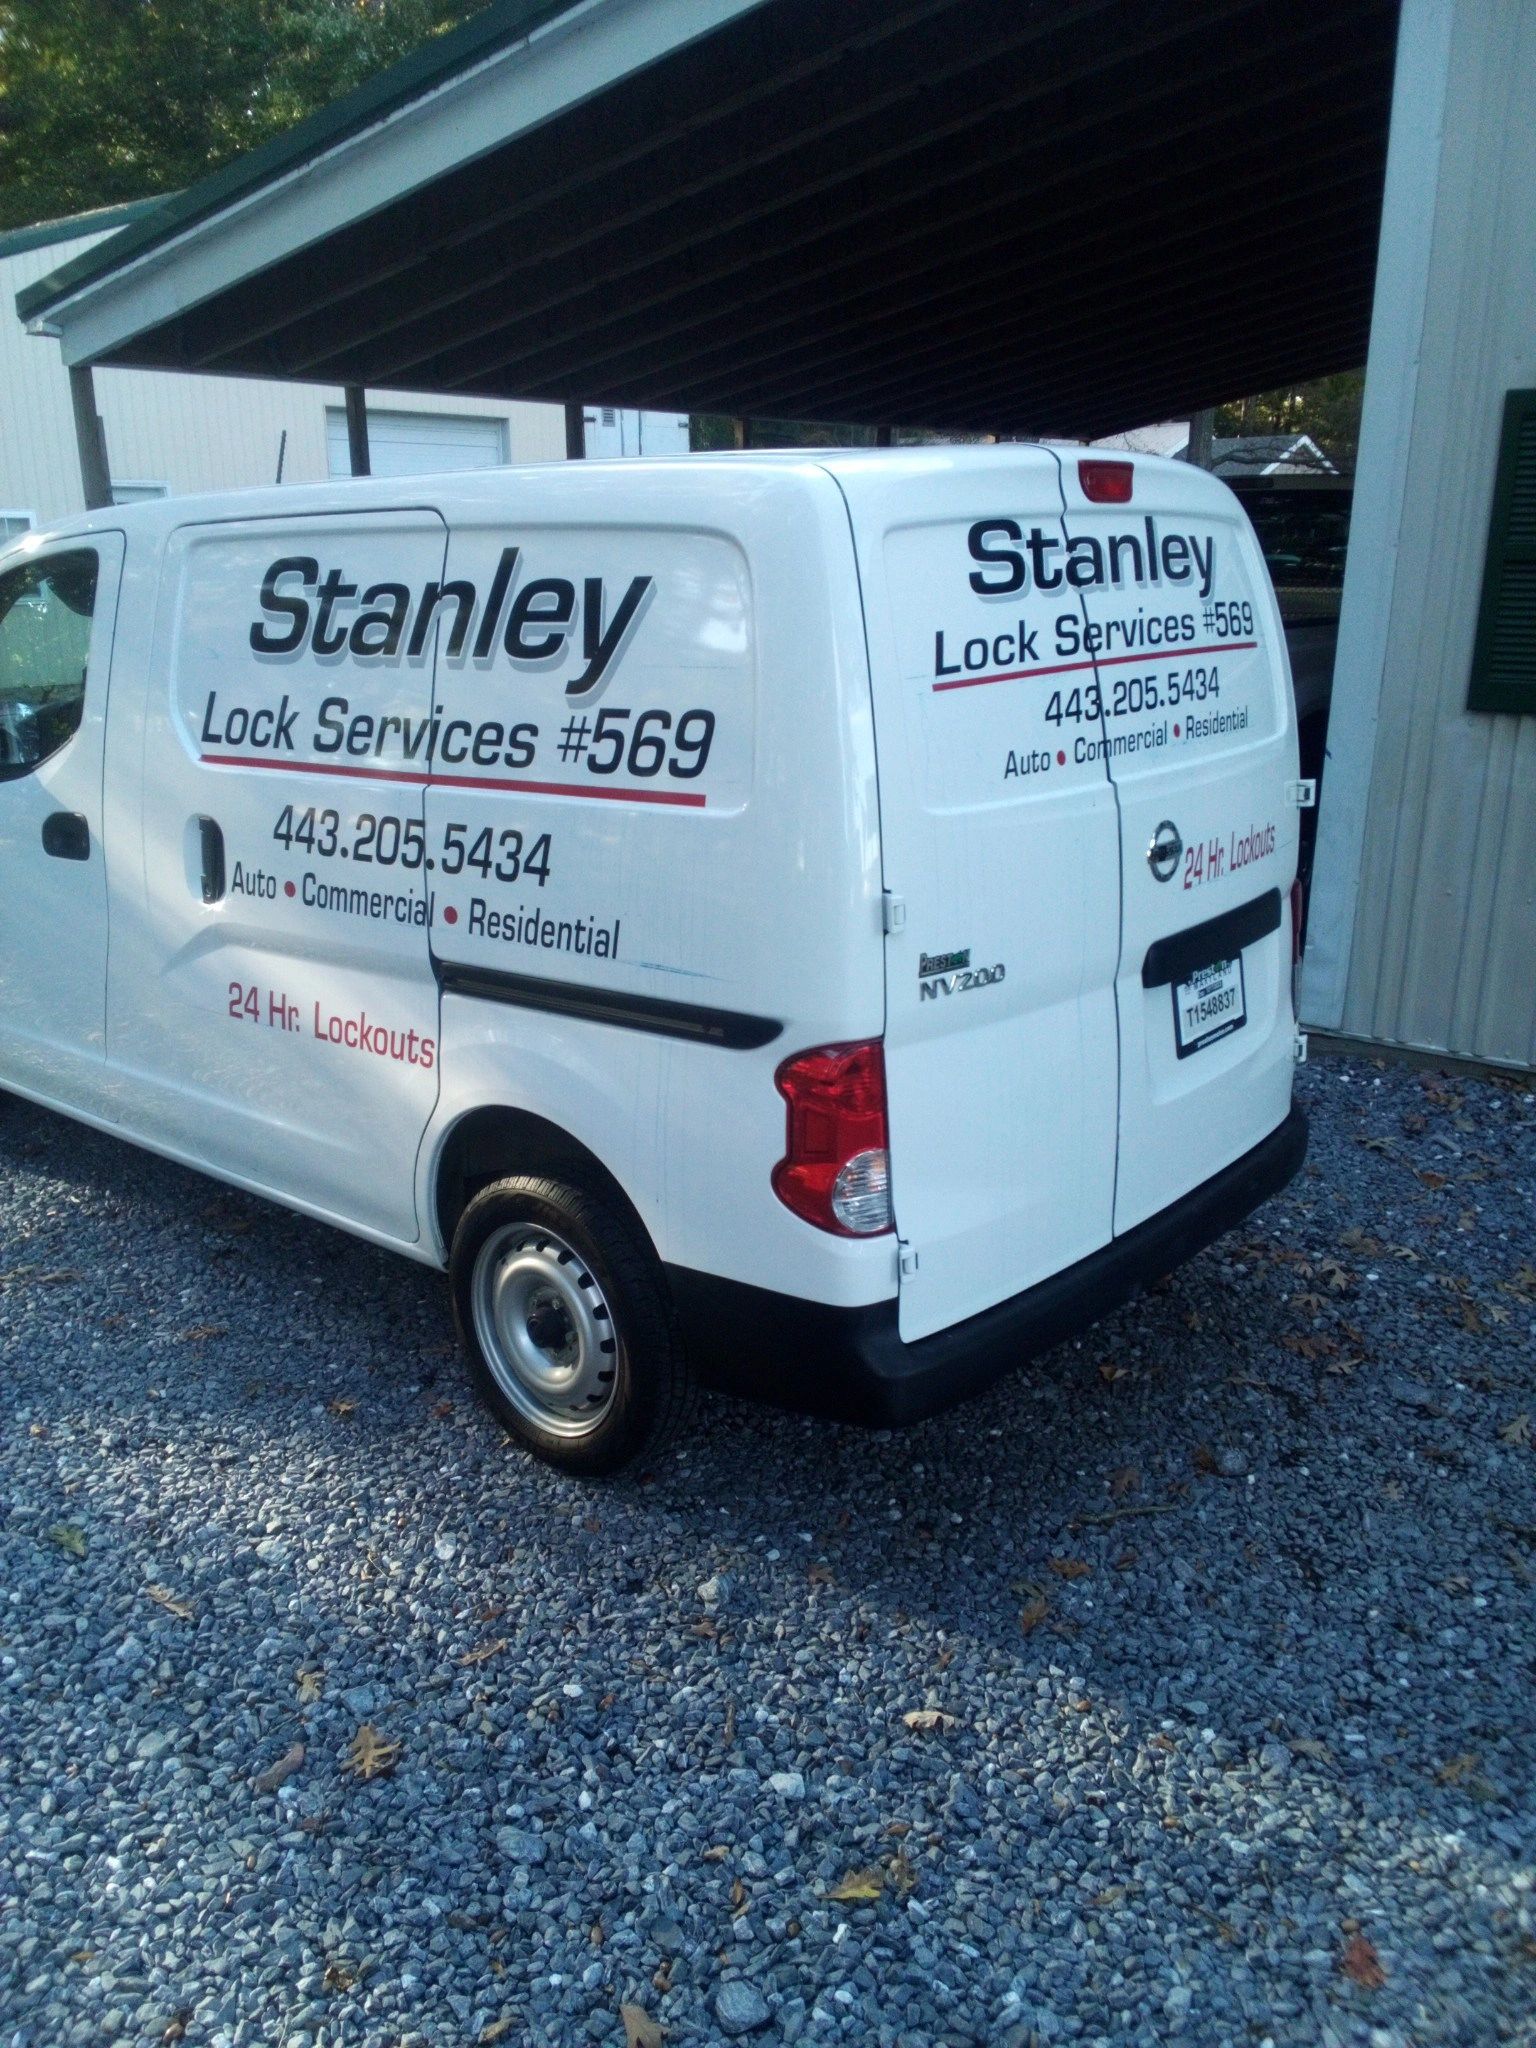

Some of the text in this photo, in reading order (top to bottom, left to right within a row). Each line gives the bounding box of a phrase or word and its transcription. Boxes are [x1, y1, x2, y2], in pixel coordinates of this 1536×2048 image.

[967, 515, 1213, 600] Stanley
[249, 546, 655, 699] Stanley
[934, 601, 1254, 676] Lock Services #569
[201, 691, 715, 778] Lock Services #569
[1044, 667, 1220, 727] 443.205.5434
[1004, 706, 1248, 779] Auto Commercial Residential
[273, 804, 552, 887] 443.205.5434
[1184, 843, 1204, 889] 24
[1207, 837, 1224, 881] Hr.
[1230, 822, 1276, 871] Lockouts
[231, 861, 621, 959] Auto Commercial Residential
[919, 963, 1006, 1002] NV200
[1186, 987, 1236, 1028] T1548837
[229, 981, 435, 1069] 24 Hr. Lockouts
